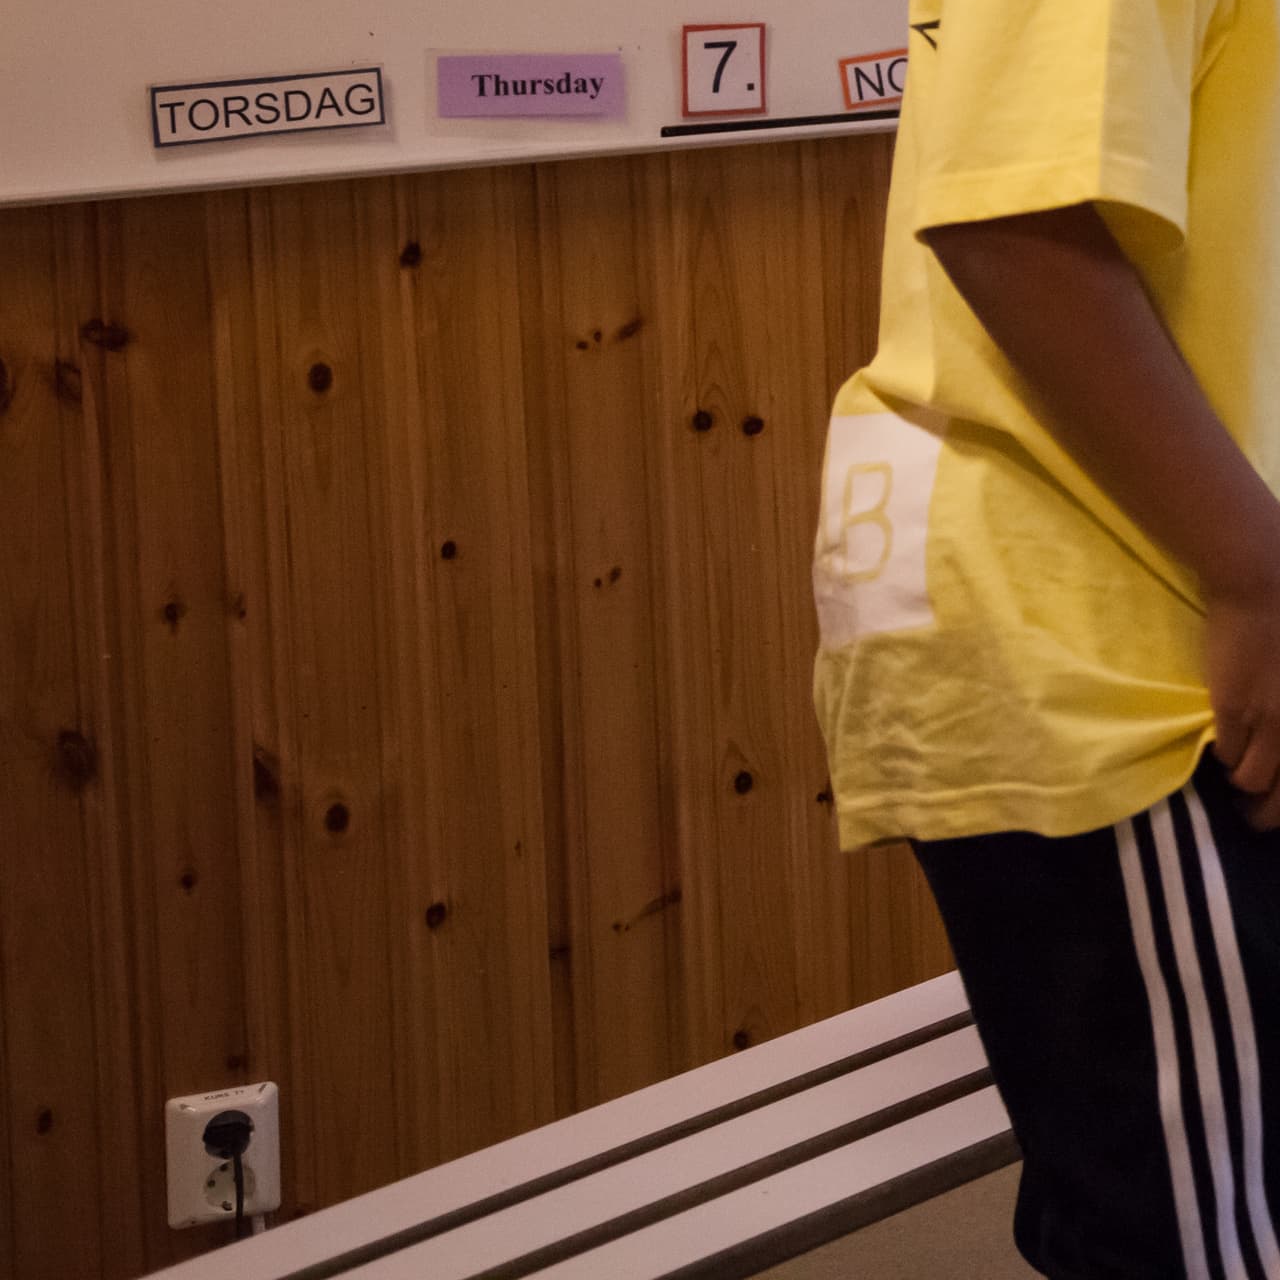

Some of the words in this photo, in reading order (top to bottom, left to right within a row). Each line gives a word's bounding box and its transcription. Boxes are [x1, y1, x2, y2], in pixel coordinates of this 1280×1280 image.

[471, 73, 604, 101] Thursday
[704, 40, 755, 94] 7.
[159, 82, 376, 135] TORSDAG
